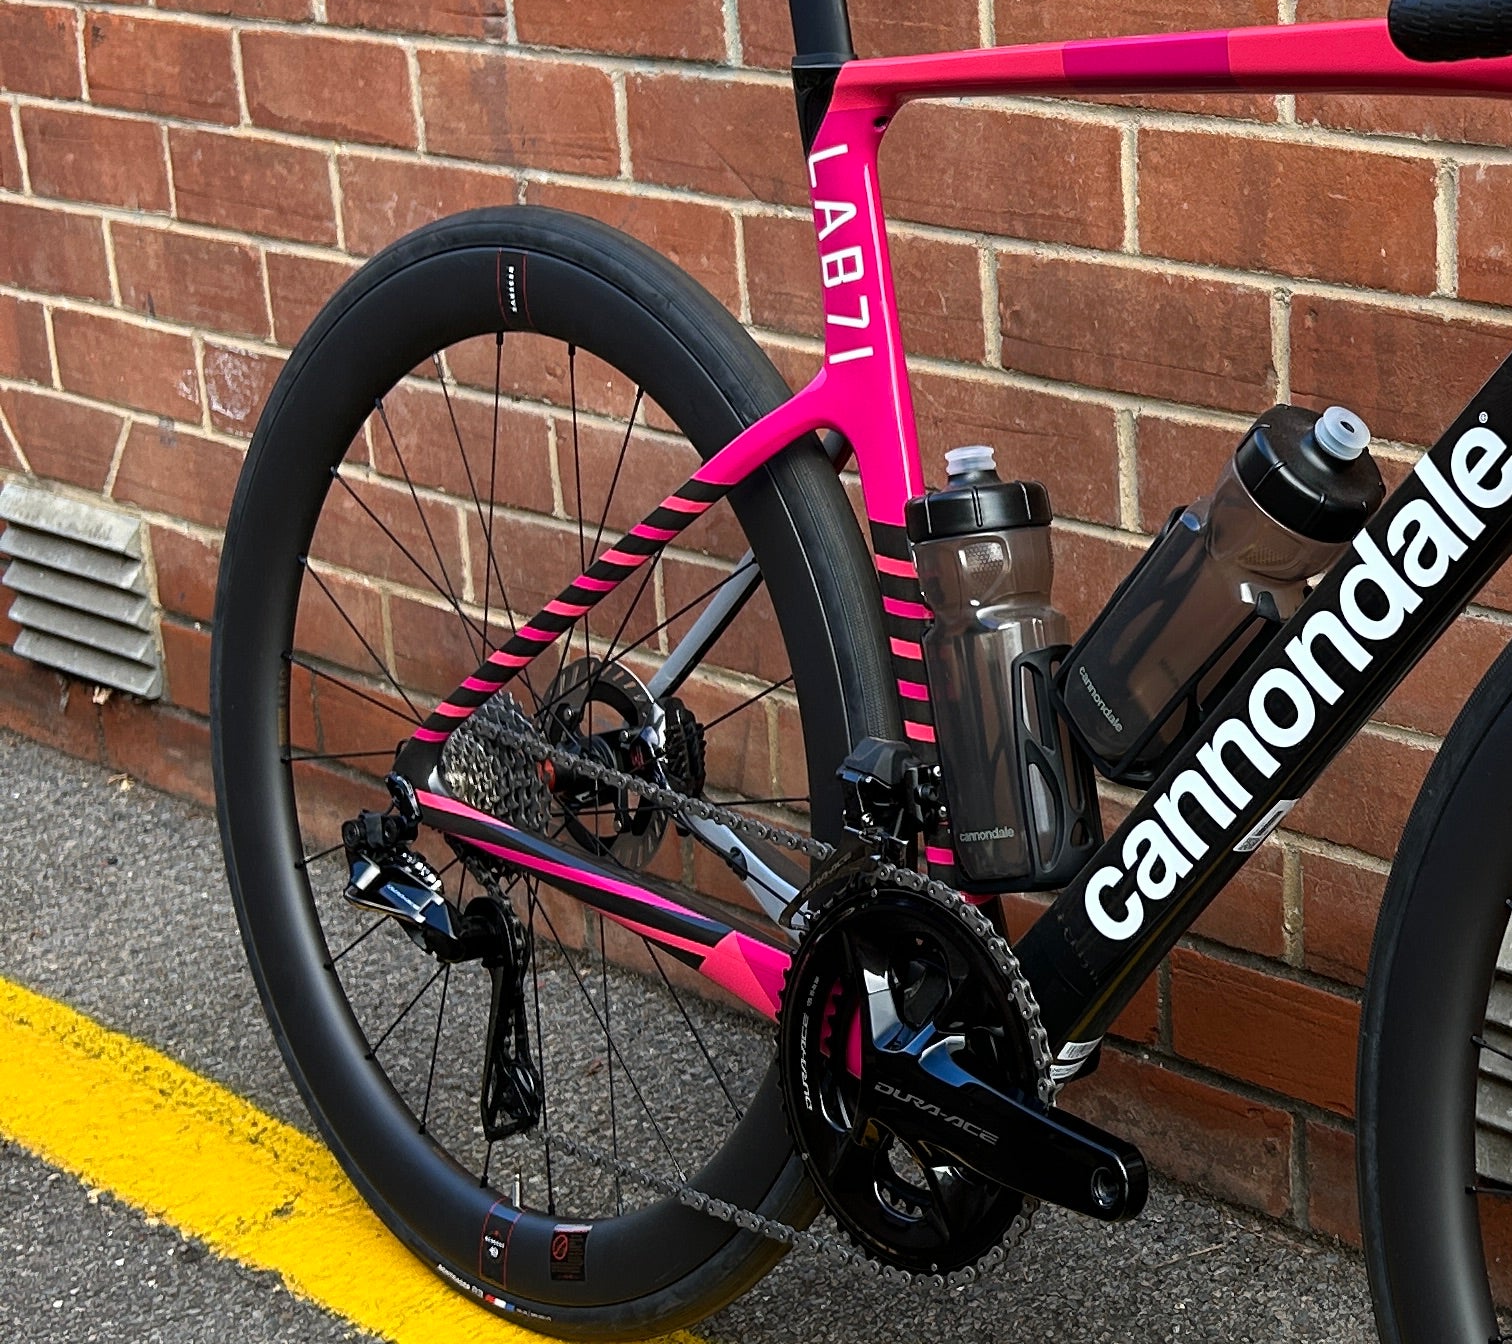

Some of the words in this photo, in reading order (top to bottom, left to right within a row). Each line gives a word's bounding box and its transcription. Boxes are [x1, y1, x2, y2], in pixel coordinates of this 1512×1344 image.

[807, 143, 874, 365] LAB71
[1078, 666, 1123, 733] cannondale
[959, 825, 1016, 843] cannondale
[873, 1081, 1000, 1147] DURA-ACE
